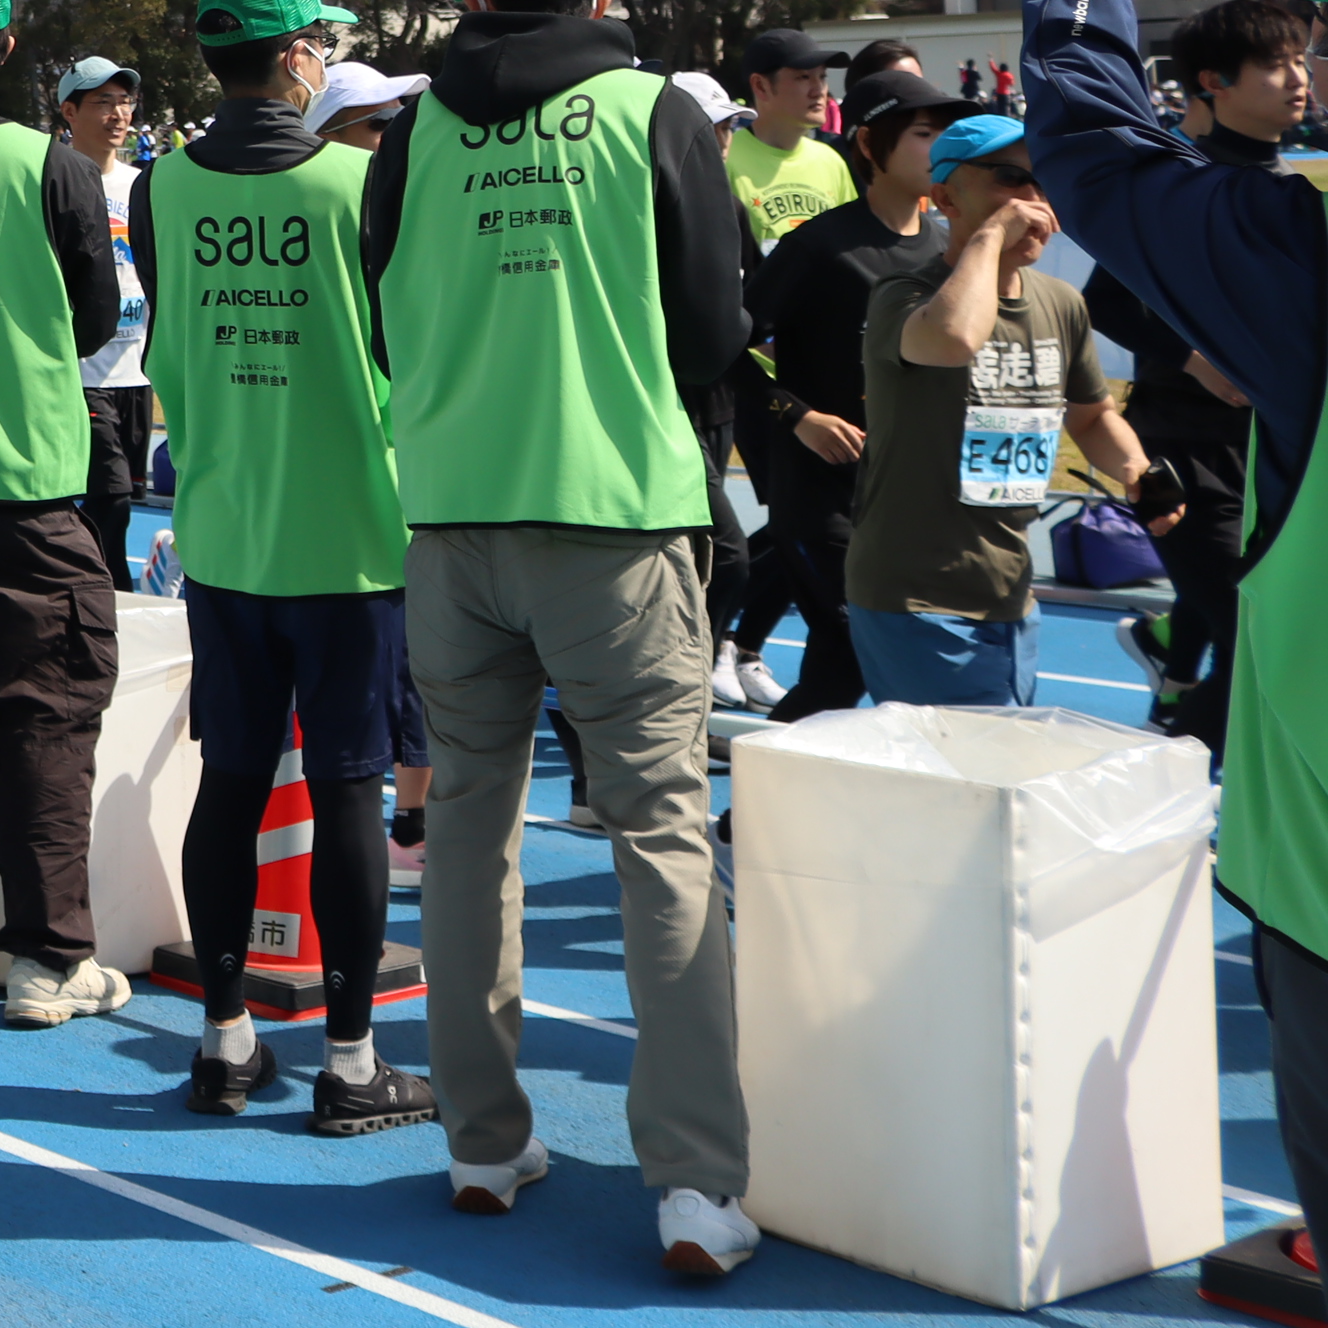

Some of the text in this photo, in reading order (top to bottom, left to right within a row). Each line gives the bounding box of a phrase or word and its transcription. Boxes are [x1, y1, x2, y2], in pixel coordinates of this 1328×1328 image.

[460, 94, 595, 150] sala
[480, 166, 585, 191] AICELLO
[509, 208, 573, 228] 日本郵政
[195, 215, 311, 267] sala
[216, 289, 309, 307] AICELLO
[244, 328, 300, 346] 日本郵政
[975, 414, 1007, 430] sala
[969, 436, 1053, 475] E 468
